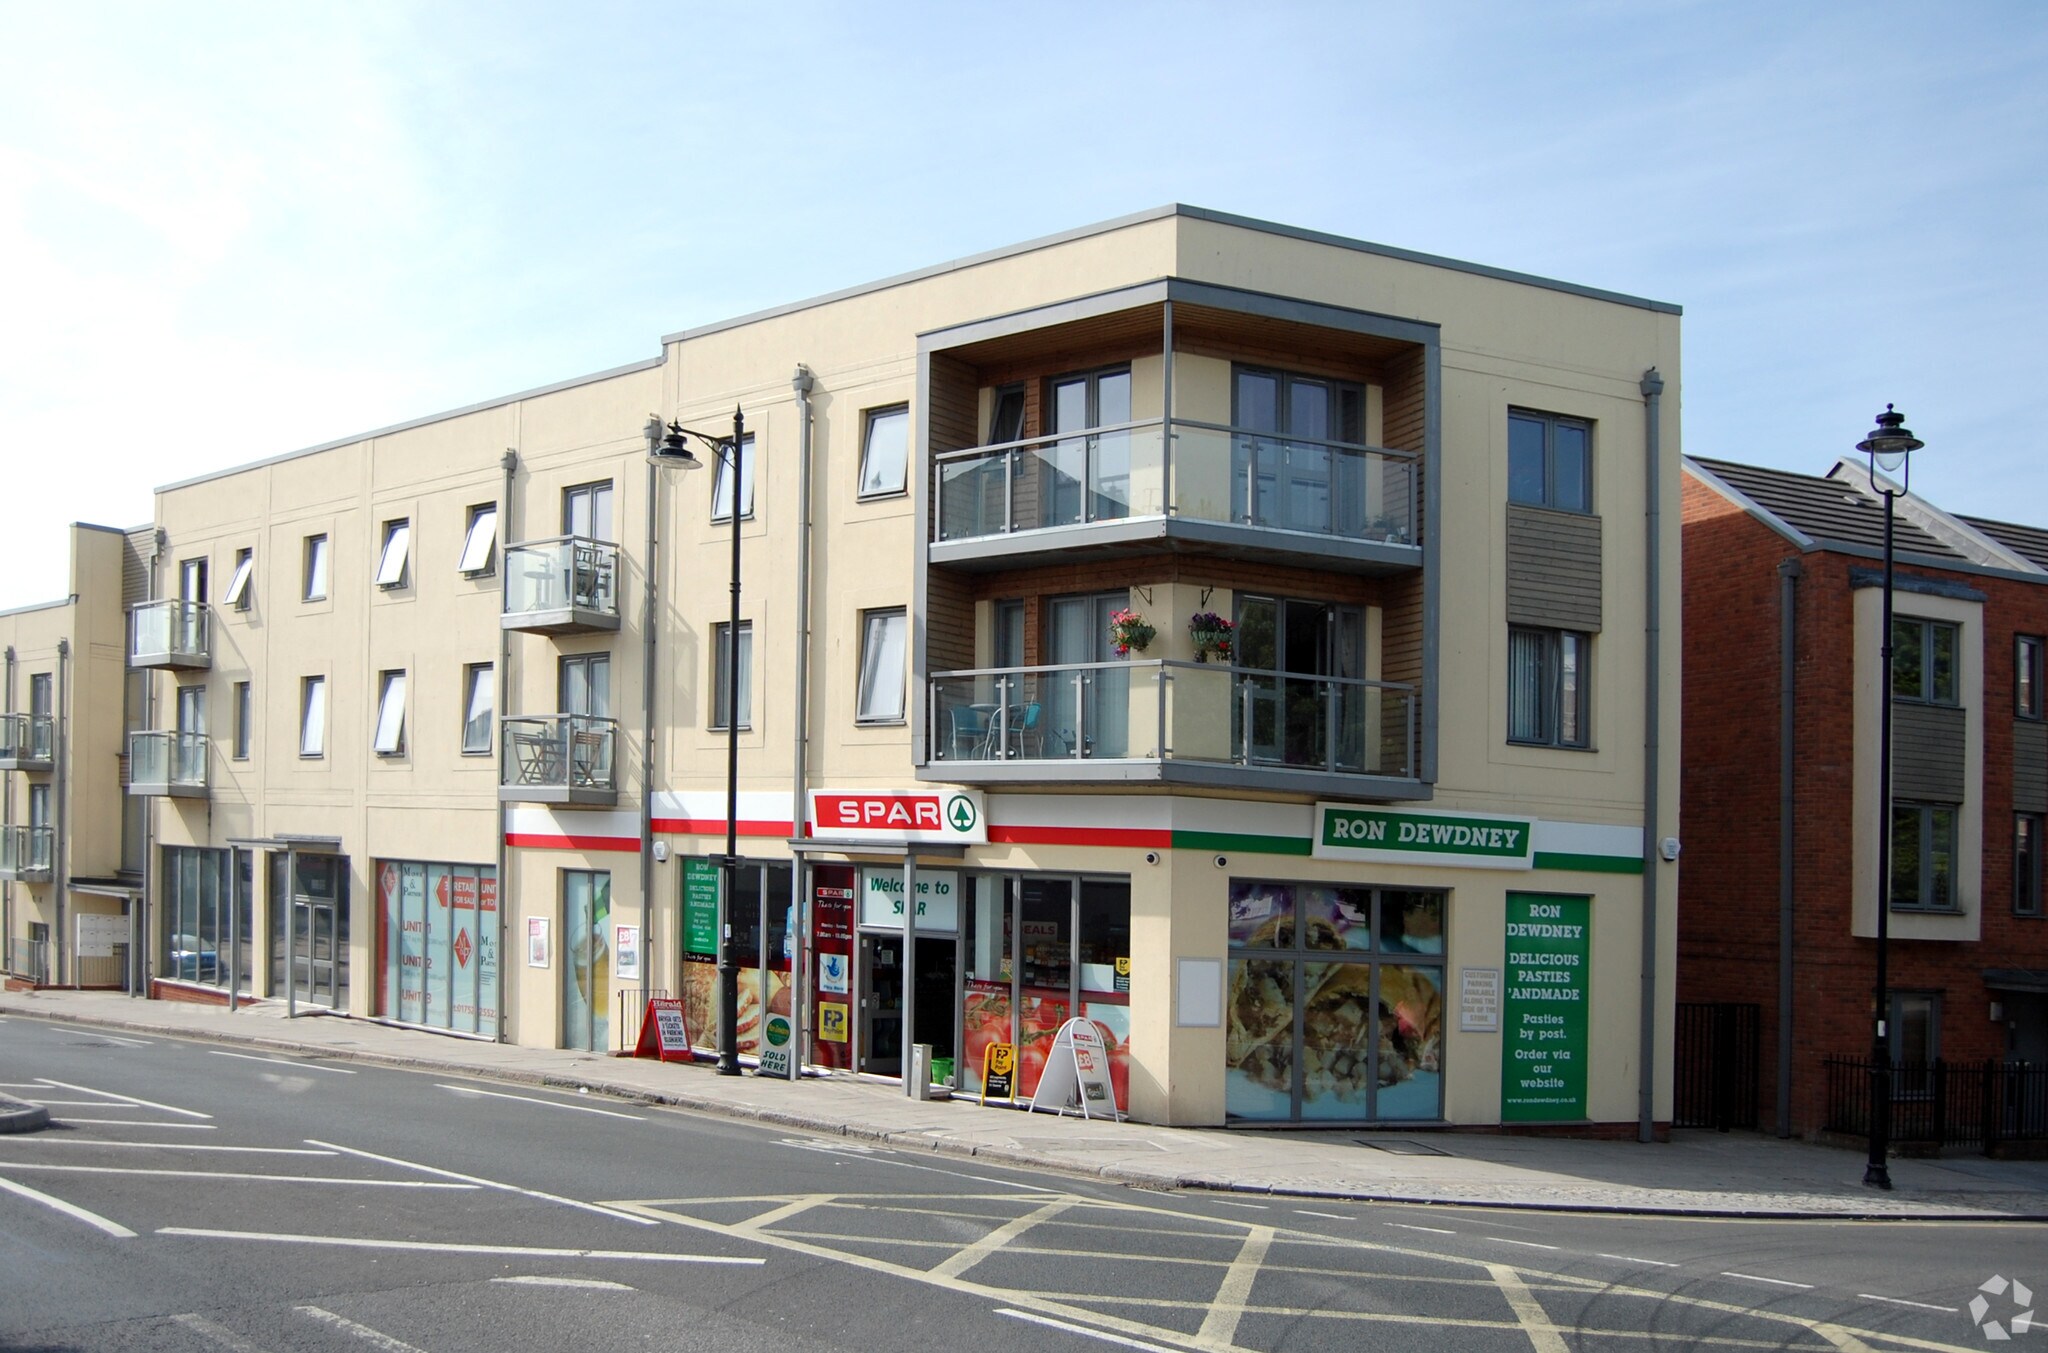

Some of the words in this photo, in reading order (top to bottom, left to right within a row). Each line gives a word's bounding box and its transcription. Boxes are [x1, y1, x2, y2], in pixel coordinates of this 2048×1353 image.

[838, 801, 939, 825] SPAR
[1333, 818, 1387, 840] RON
[1398, 822, 1520, 848] DEWDNEY
[687, 872, 717, 882] DEWDNEY
[410, 879, 416, 888] &
[454, 882, 475, 893] RETAIL
[871, 878, 929, 894] Welce
[935, 881, 950, 895] to
[893, 900, 926, 916] SR
[1529, 904, 1561, 918] RON
[402, 921, 422, 932] UNIT
[427, 923, 432, 934] 1
[1022, 925, 1056, 935] EALS
[1507, 923, 1582, 938] DEWDNEY
[488, 949, 494, 959] &
[1510, 952, 1579, 966] DELICIOUS
[402, 955, 422, 967] UNIT
[427, 958, 432, 969] 2
[1518, 970, 1570, 982] PASTIES
[402, 989, 422, 1002] UNIT
[1508, 988, 1580, 1000] 'ANDMADE
[653, 1000, 682, 1008] Herald
[1523, 1014, 1564, 1024] Pasties
[1520, 1028, 1534, 1040] by
[1539, 1028, 1566, 1040] post.
[764, 1050, 786, 1062] SOLD
[1078, 1053, 1092, 1067] £8
[1515, 1049, 1548, 1060] Order
[1552, 1050, 1570, 1060] via
[760, 1060, 786, 1072] HERE
[1533, 1065, 1552, 1074] our
[1520, 1078, 1564, 1088] website
